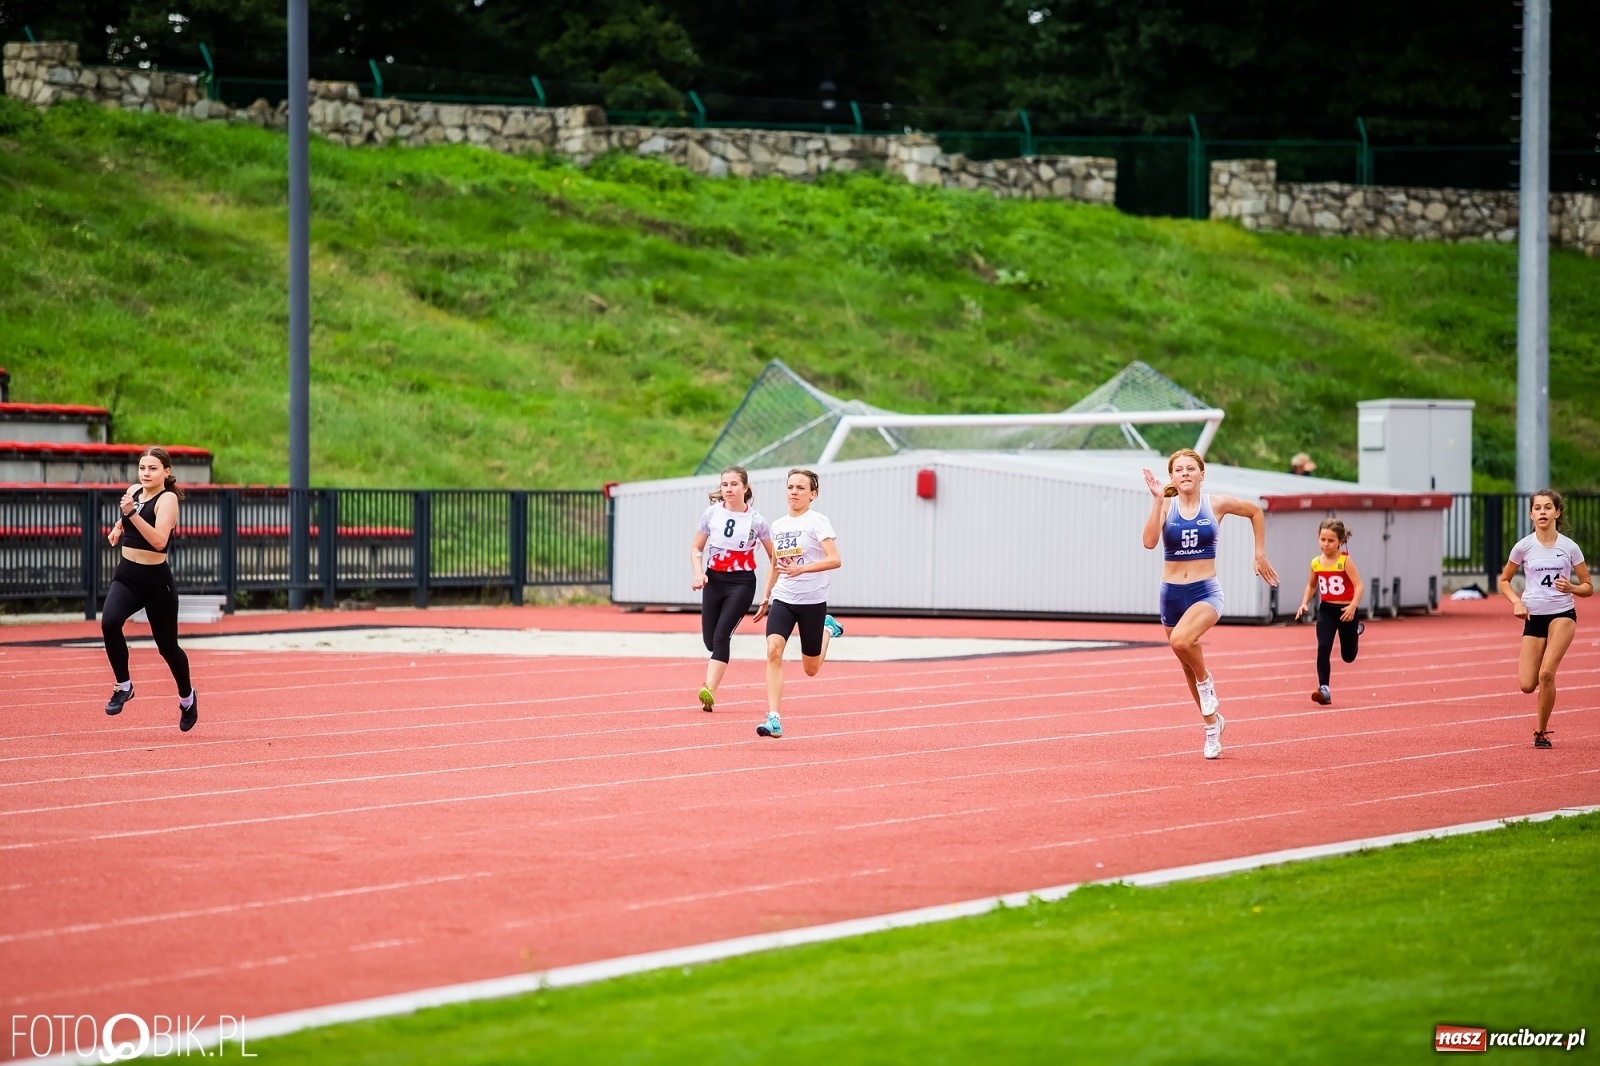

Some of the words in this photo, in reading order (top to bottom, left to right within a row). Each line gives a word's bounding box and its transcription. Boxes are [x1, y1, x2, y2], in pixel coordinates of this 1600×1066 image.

[724, 519, 735, 537] 8
[777, 538, 797, 549] 234
[1181, 528, 1199, 548] 55
